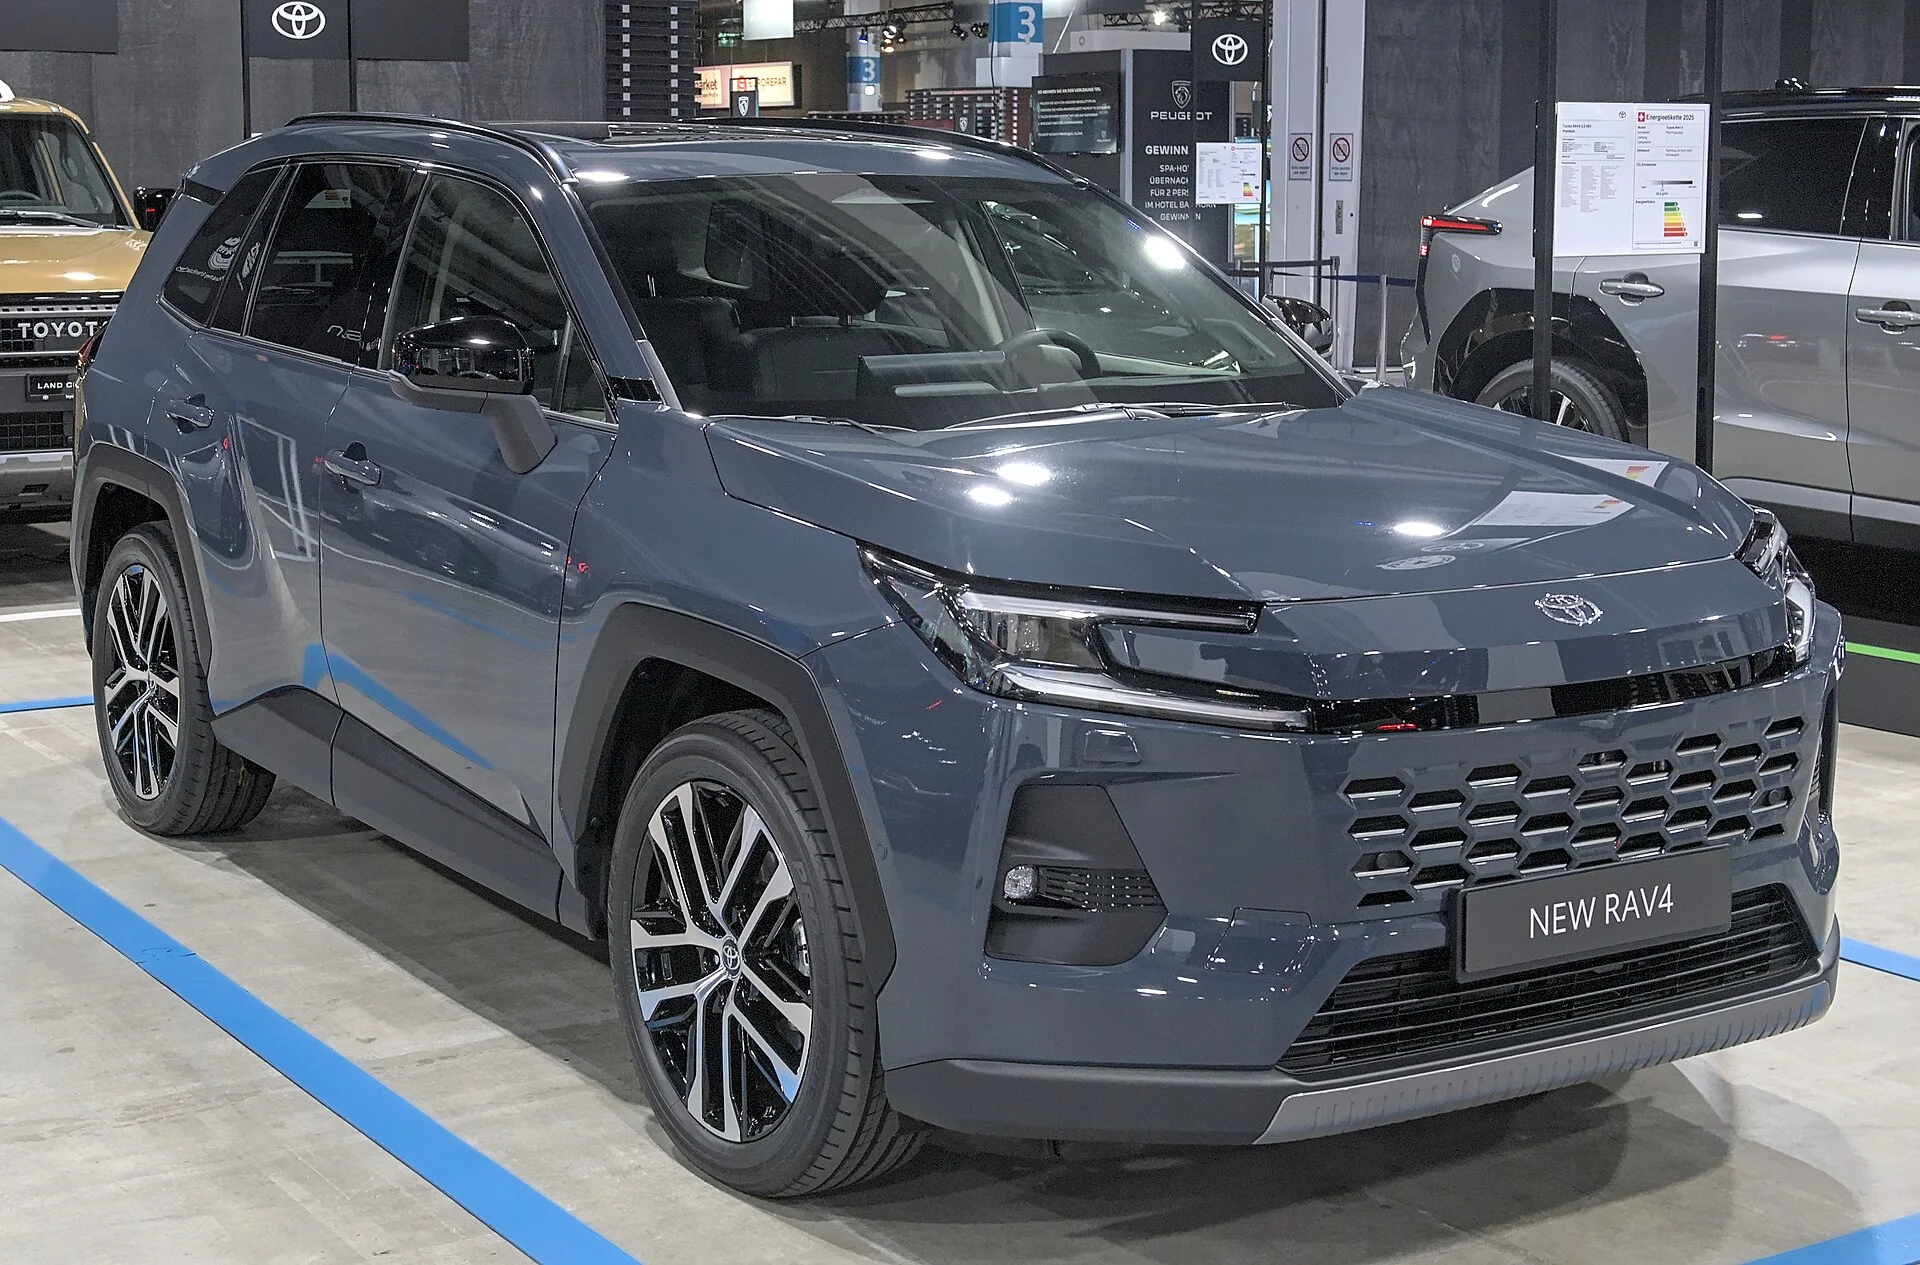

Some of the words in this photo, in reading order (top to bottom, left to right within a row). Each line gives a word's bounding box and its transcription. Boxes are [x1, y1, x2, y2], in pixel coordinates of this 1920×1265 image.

[1017, 5, 1036, 40] 3
[862, 58, 876, 82] 3
[748, 77, 786, 87] EROREPAR
[1150, 111, 1212, 120] PEUGEOT
[1646, 113, 1682, 122] Energieetikette
[1145, 145, 1189, 155] GEWINN
[1160, 164, 1189, 172] SPA-HO
[1150, 188, 1165, 197] FÜR
[1166, 188, 1171, 197] 2
[1145, 201, 1153, 209] IM
[1155, 201, 1179, 209] HOTEL
[1160, 212, 1201, 221] GEWINNN
[17, 321, 108, 338] TOYOT
[37, 382, 63, 390] LAND
[1529, 896, 1597, 939] NEW
[1605, 883, 1674, 925] RAV4
